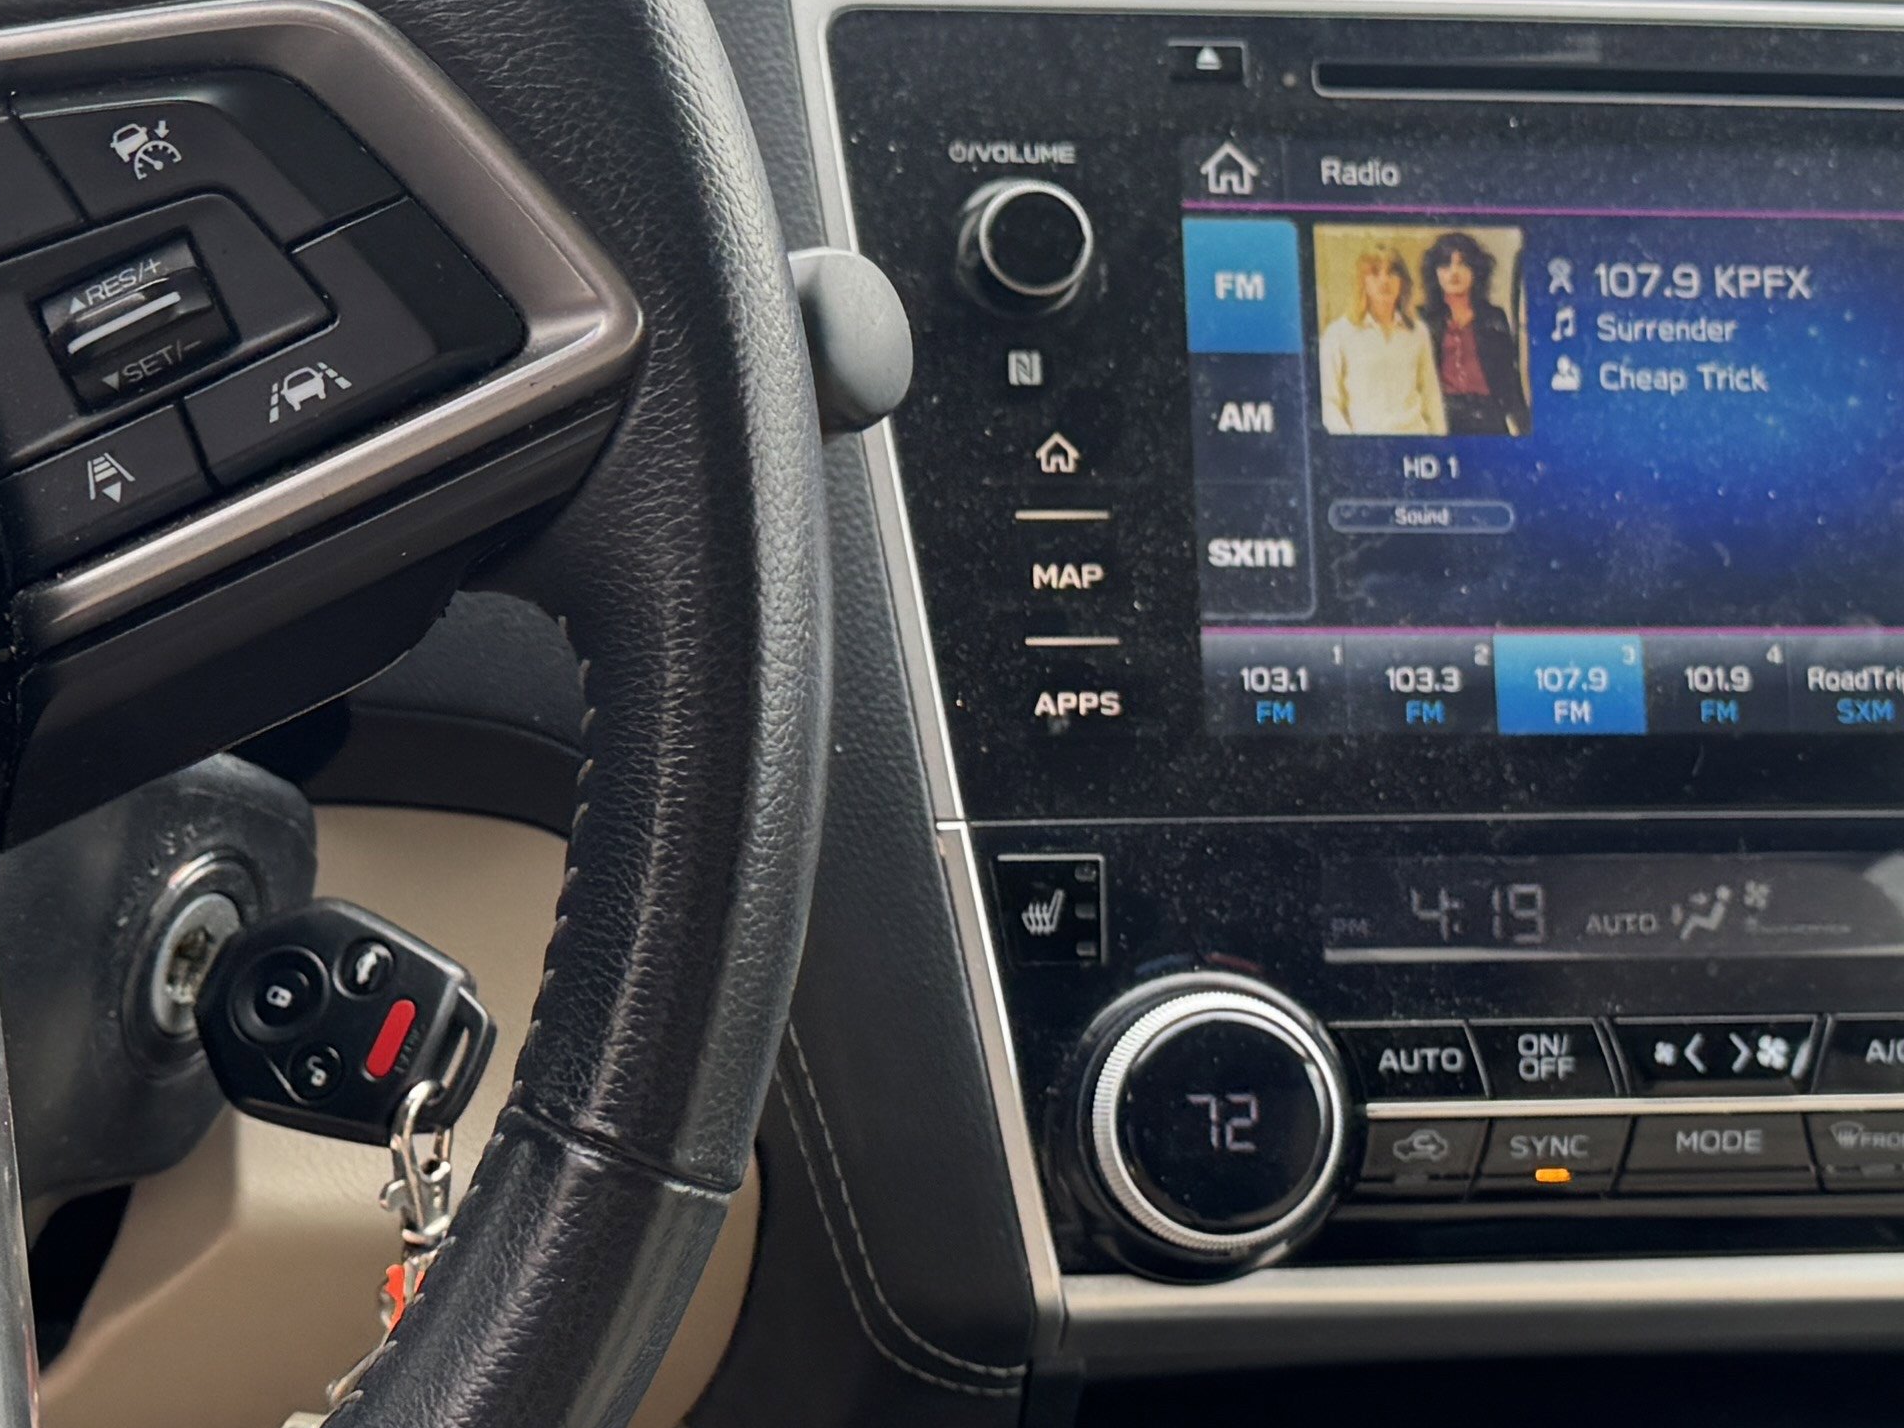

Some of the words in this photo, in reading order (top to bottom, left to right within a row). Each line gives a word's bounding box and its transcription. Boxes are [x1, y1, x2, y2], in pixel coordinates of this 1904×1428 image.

[1320, 158, 1402, 188] Radio
[1215, 272, 1265, 301] FM
[1595, 262, 1702, 299] 107.9
[1714, 264, 1813, 300] KPFX
[1596, 312, 1738, 343] Surrender
[1599, 361, 1688, 396] Cheap
[1696, 362, 1769, 393] Trick
[1218, 402, 1274, 433] AM
[1404, 456, 1439, 479] HD
[1395, 507, 1449, 526] Sound
[1032, 563, 1104, 590] MAP
[1240, 667, 1310, 693] 103.1
[1385, 667, 1462, 693] 103.3
[1535, 667, 1608, 693] 107.9
[1686, 666, 1752, 693] 101.9
[1034, 691, 1121, 717] APPS
[1256, 700, 1295, 725] FM
[1406, 700, 1445, 725] FM
[1554, 700, 1592, 725] FM
[1700, 699, 1739, 724] FM
[1836, 698, 1894, 724] SXM
[1586, 912, 1658, 937] AUTO
[1517, 1032, 1570, 1057] ON/
[1378, 1047, 1466, 1073] AUTO
[1518, 1057, 1576, 1082] OFF
[1187, 1093, 1259, 1154] 72
[1509, 1134, 1591, 1159] SYNC
[1676, 1129, 1764, 1155] MODE
